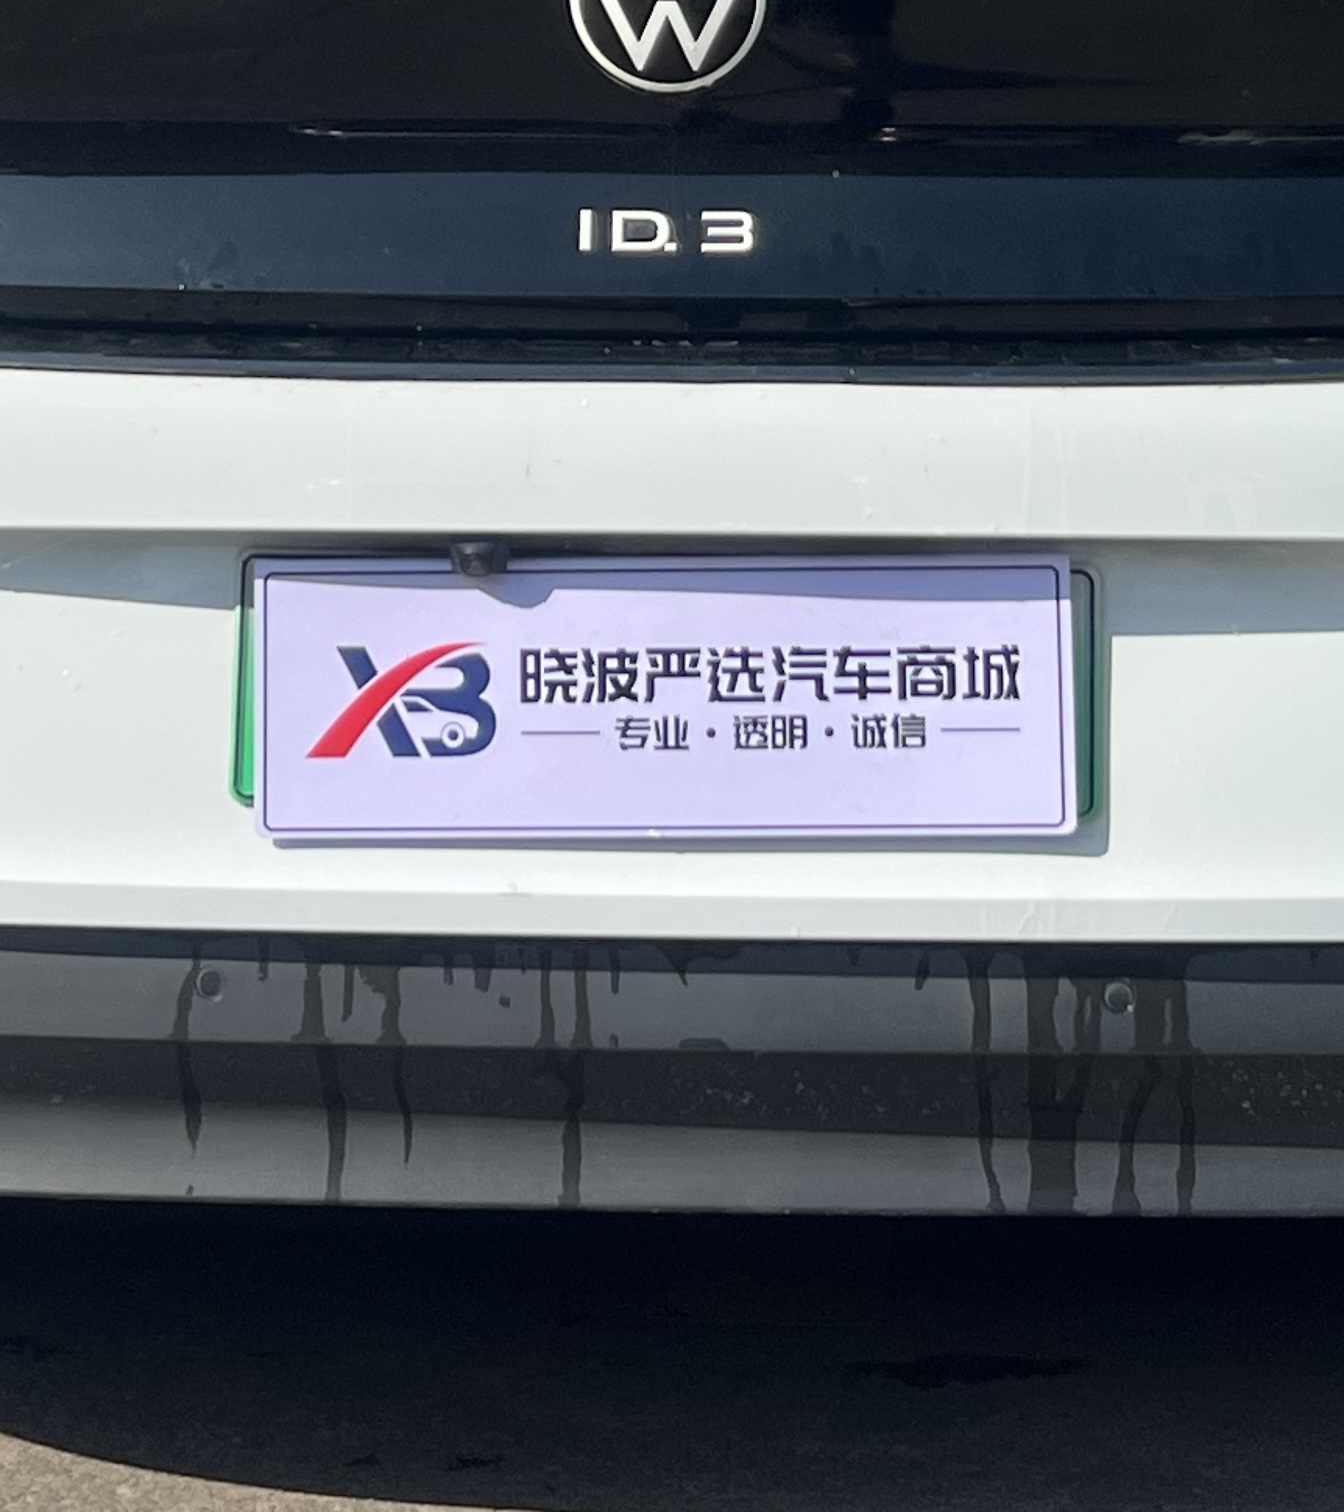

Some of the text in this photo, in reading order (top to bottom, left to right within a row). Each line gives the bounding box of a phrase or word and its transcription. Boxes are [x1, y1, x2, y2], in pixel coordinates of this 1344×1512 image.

[519, 644, 1021, 704] 晓波严选汽车商城
